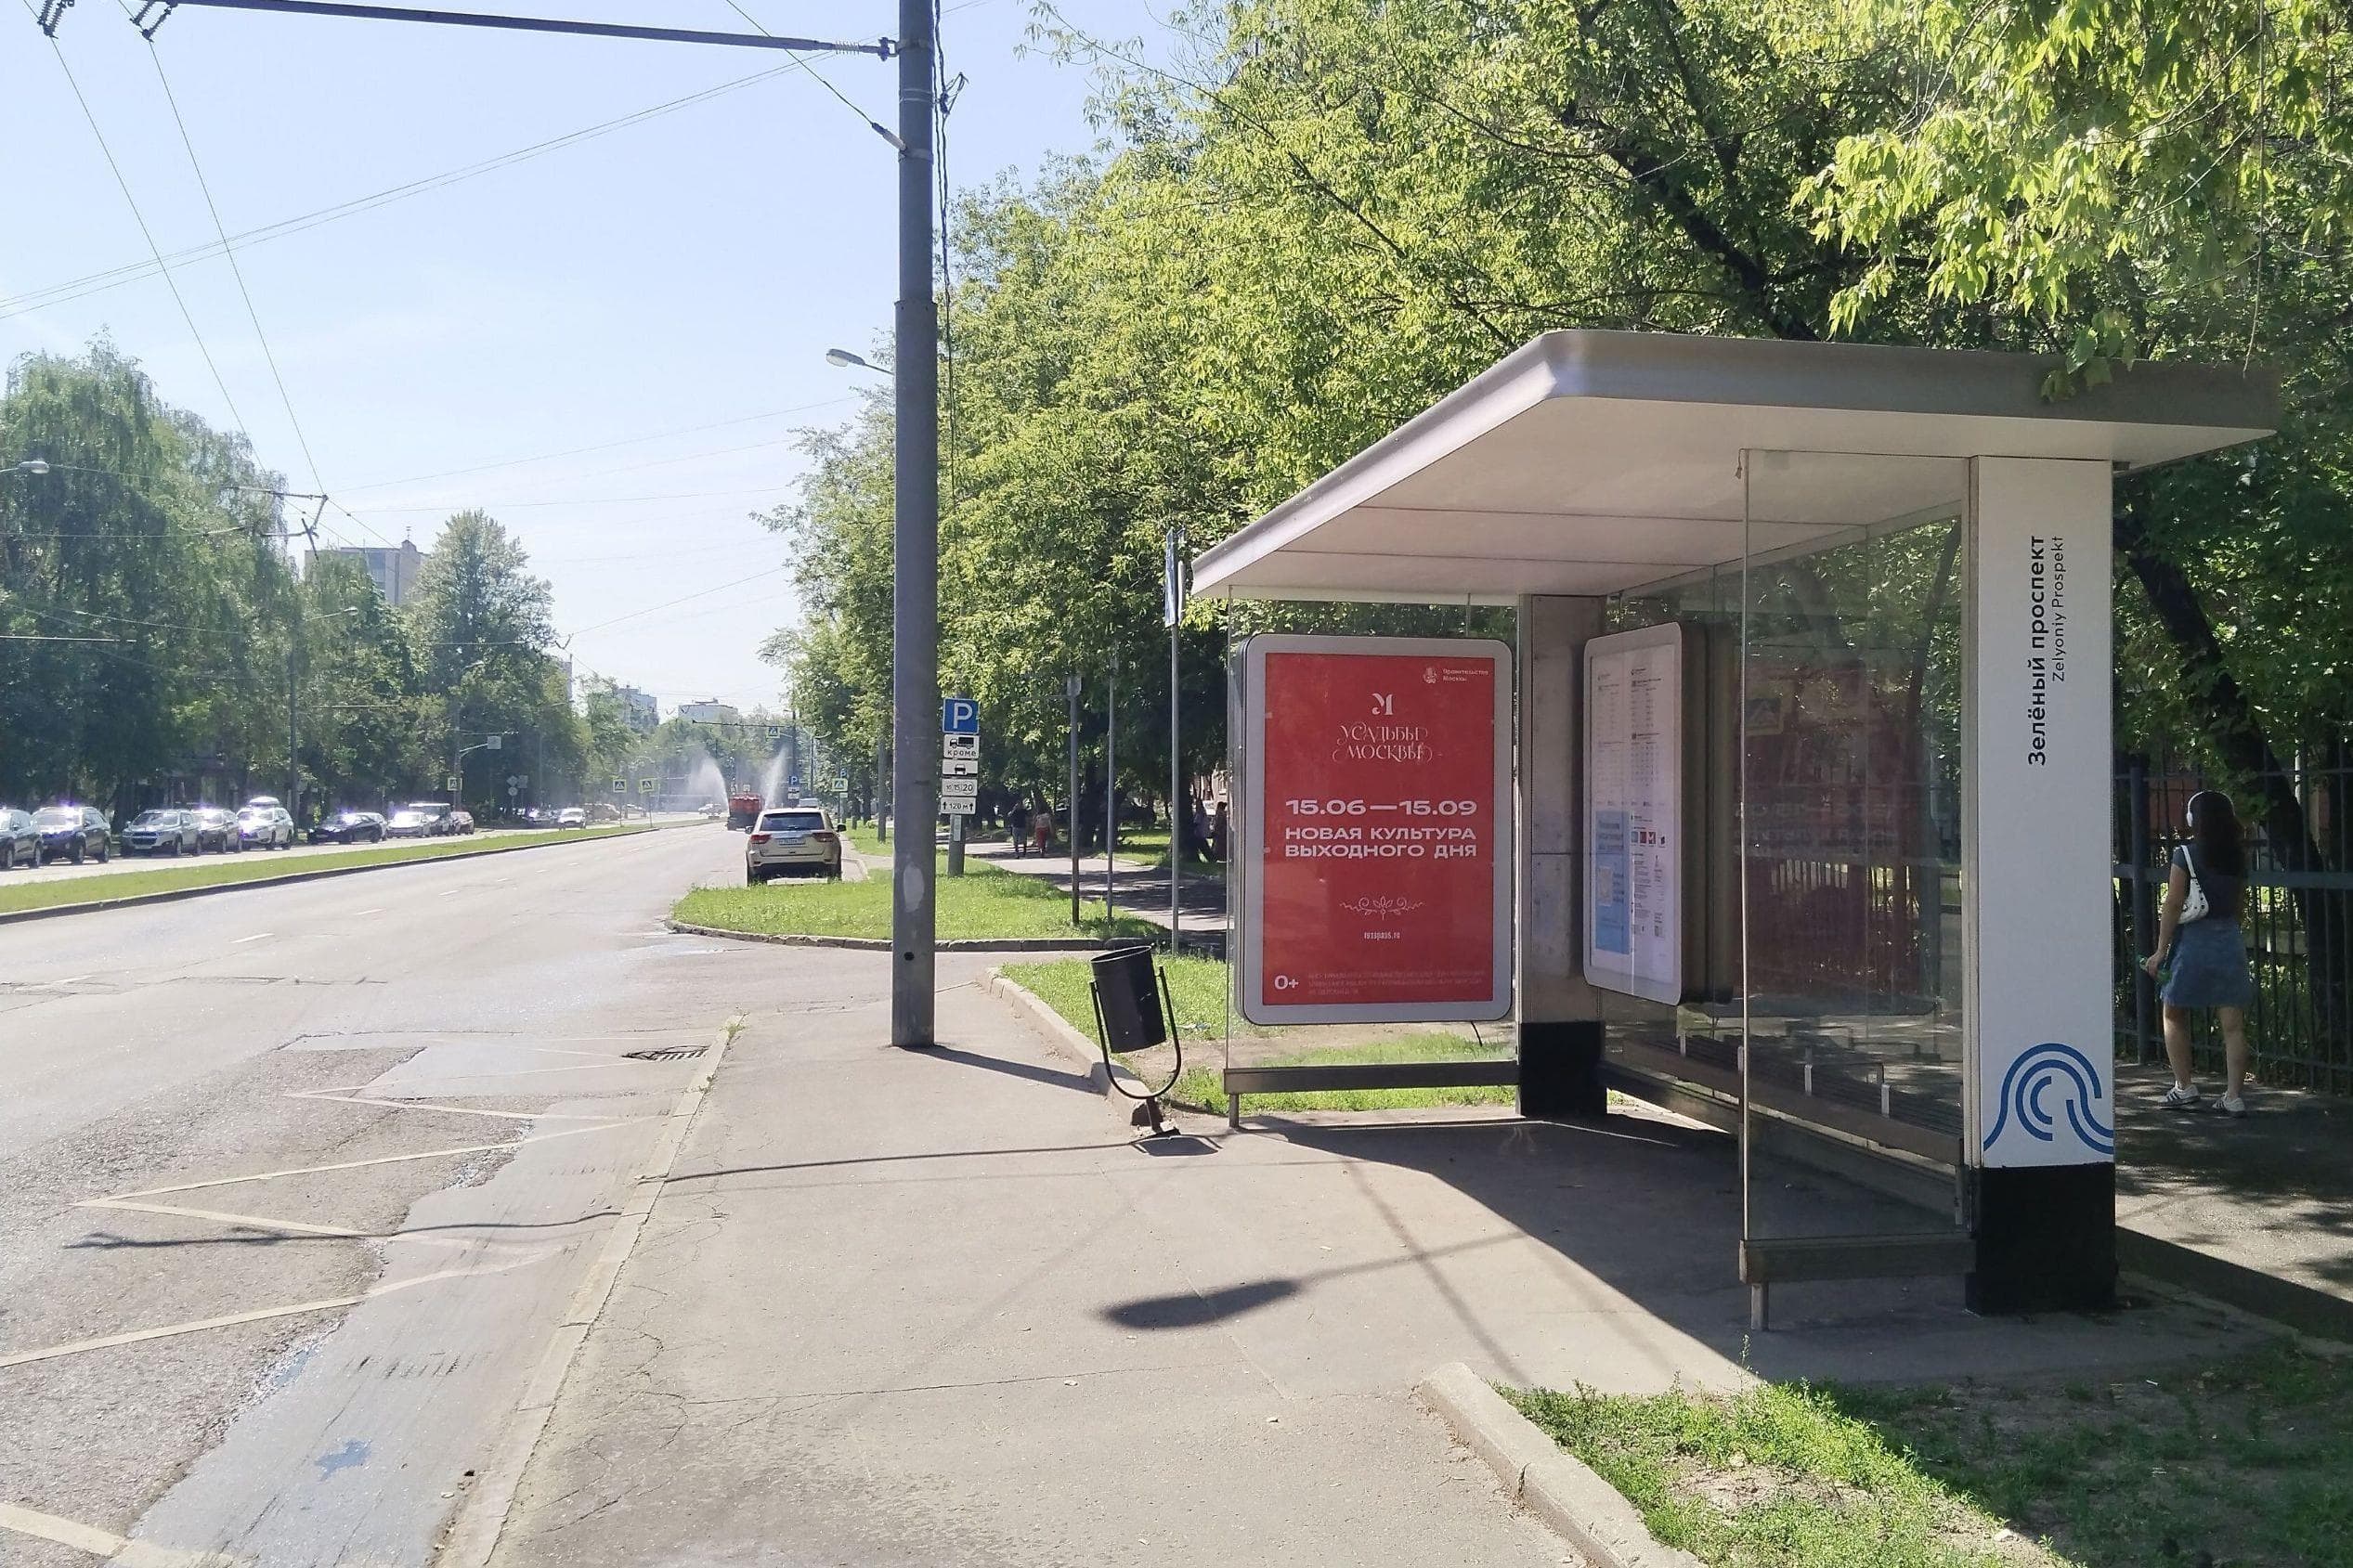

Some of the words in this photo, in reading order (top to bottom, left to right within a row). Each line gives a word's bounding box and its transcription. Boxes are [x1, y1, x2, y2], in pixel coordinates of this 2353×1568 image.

[2051, 536, 2067, 608] Prospekt
[2030, 536, 2049, 649] проспект
[2051, 613, 2067, 682] Zelyoniy
[953, 703, 973, 729] P
[2027, 656, 2047, 766] Зелёный
[1336, 721, 1428, 745] УСАДЬБЫ
[947, 749, 977, 758] кроме
[1332, 743, 1433, 763] МОСКВЫ
[962, 784, 973, 792] 20
[1285, 827, 1362, 840] НОВАЯ
[1370, 826, 1476, 841] КУЛЬТУРА
[1285, 844, 1424, 859] ВЫХОДНОГО
[1434, 844, 1477, 859] ДНЯ
[1273, 975, 1299, 991] 0+
